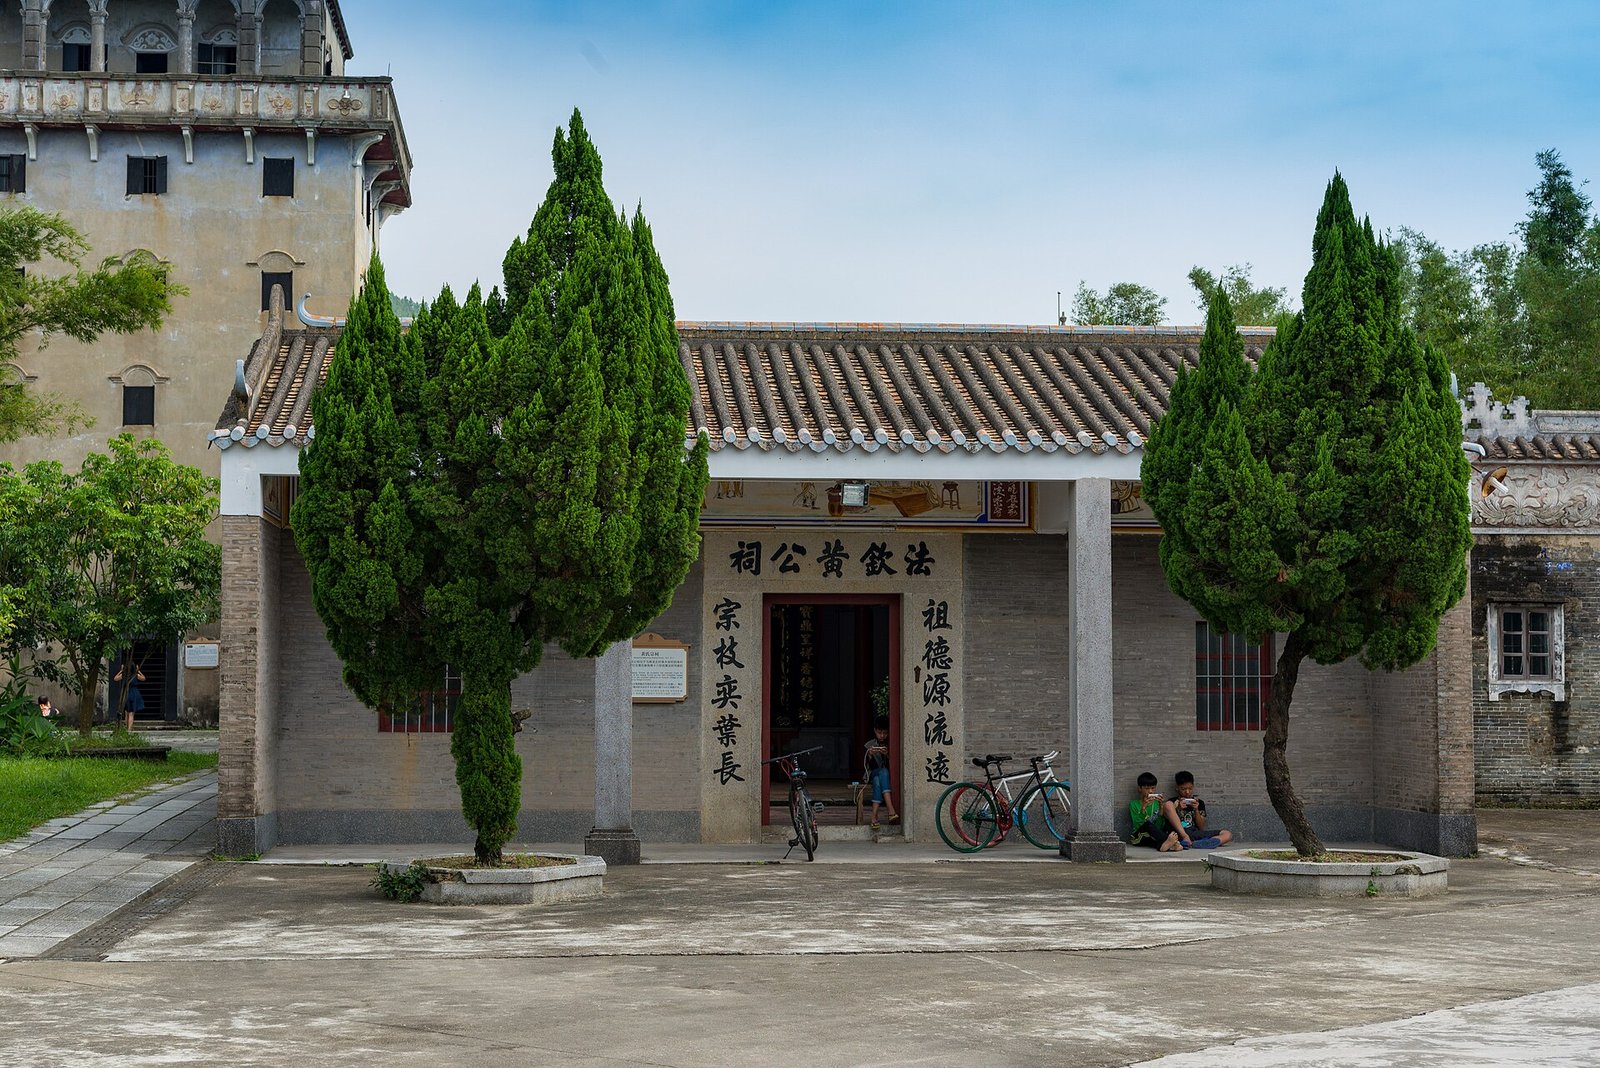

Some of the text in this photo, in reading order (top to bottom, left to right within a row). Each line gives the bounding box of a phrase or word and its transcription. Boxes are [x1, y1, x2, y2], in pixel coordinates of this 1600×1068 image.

[711, 597, 746, 786] 宗枝奕葉長
[921, 598, 957, 786] 祖德源流遠
